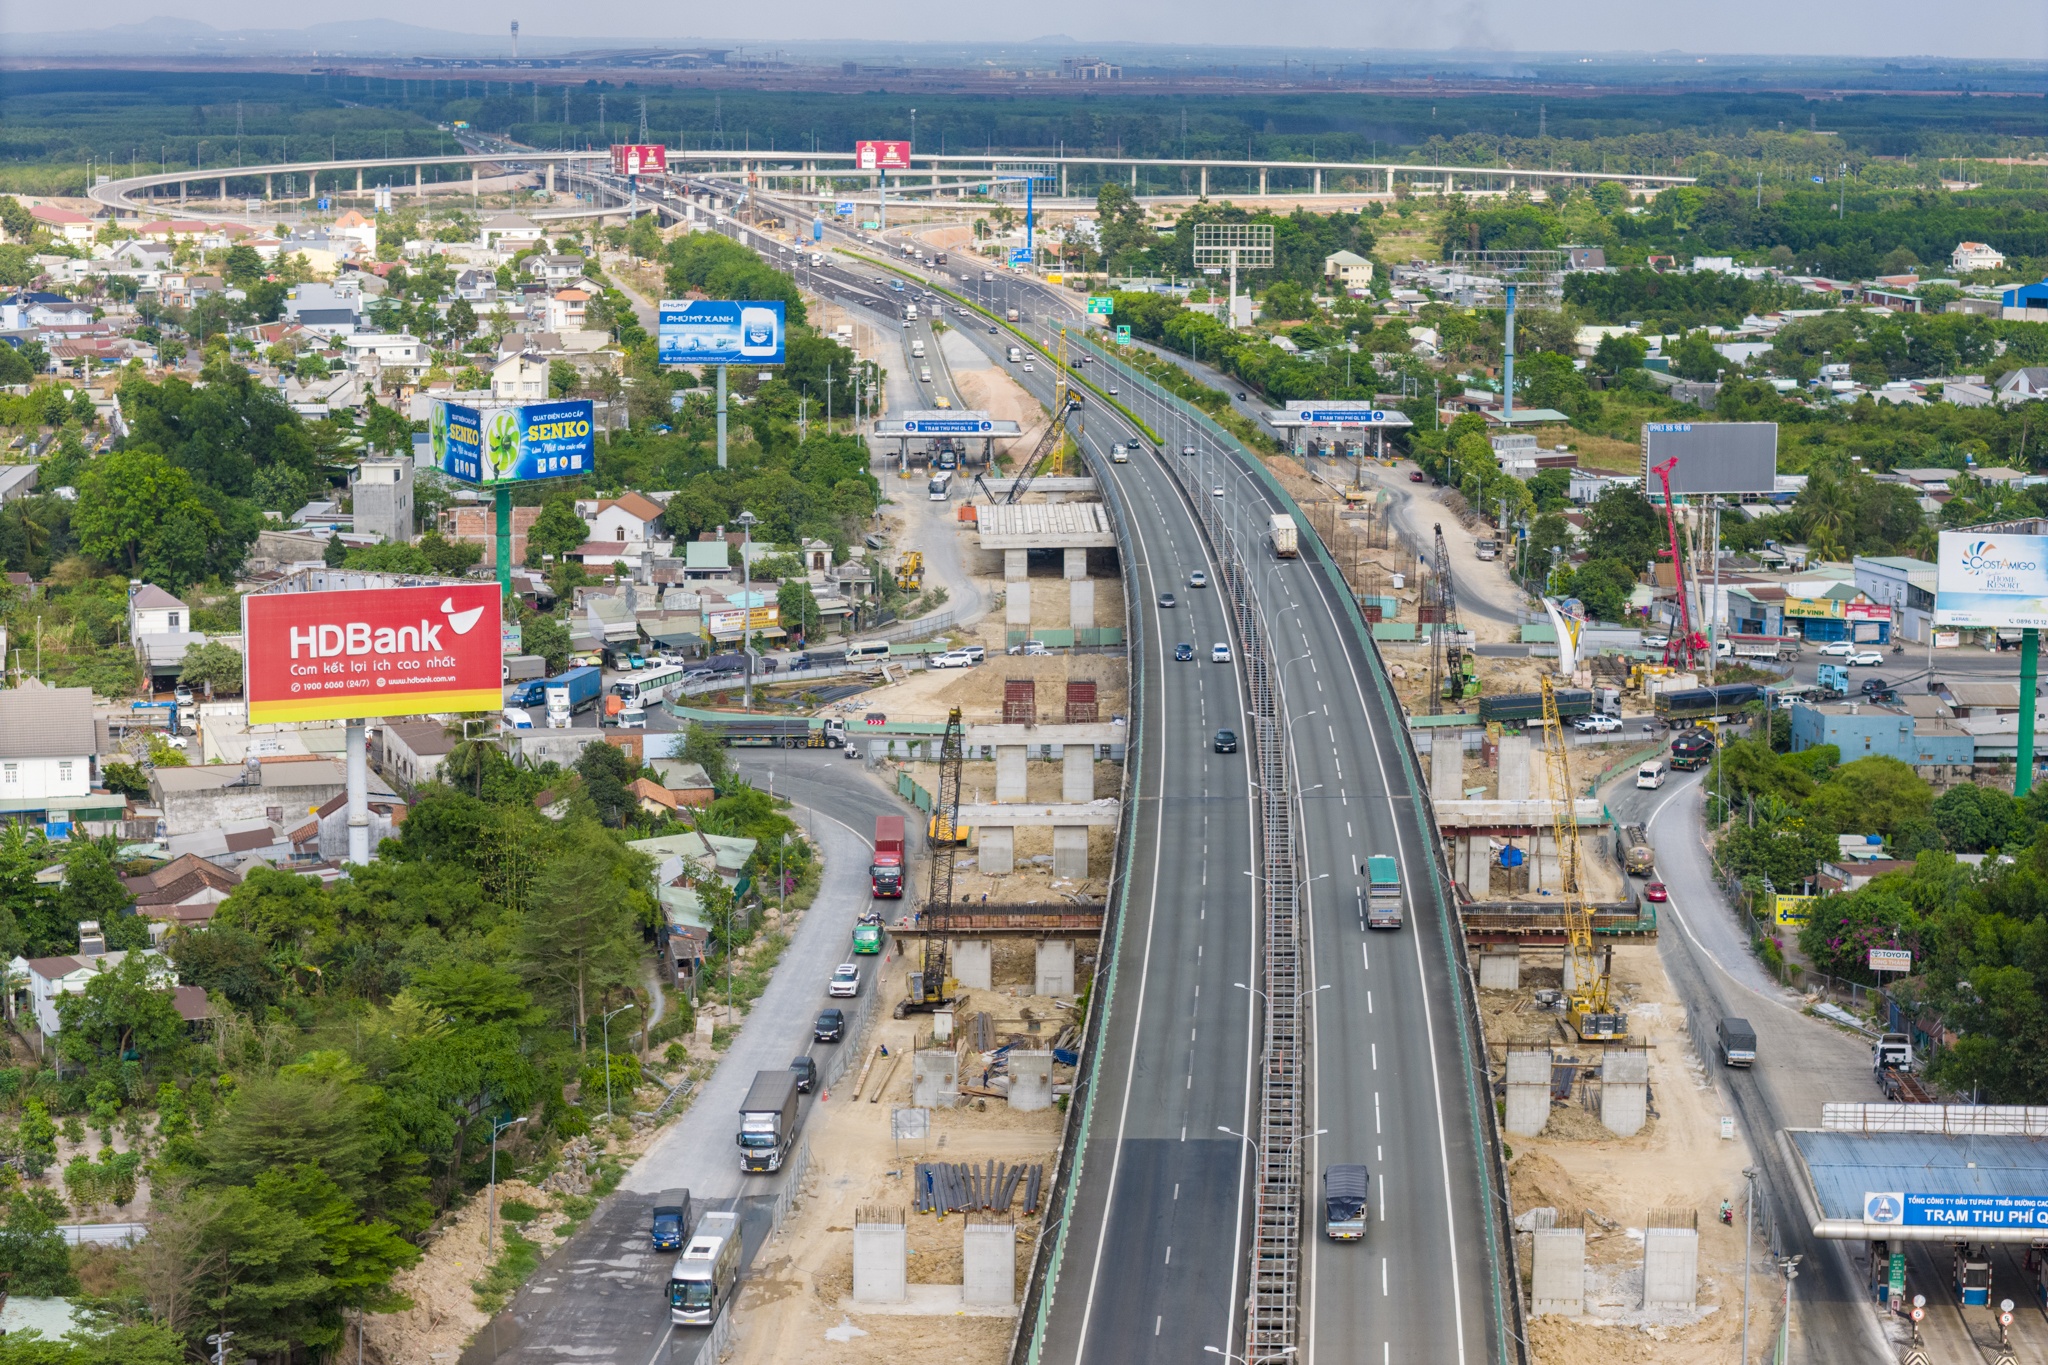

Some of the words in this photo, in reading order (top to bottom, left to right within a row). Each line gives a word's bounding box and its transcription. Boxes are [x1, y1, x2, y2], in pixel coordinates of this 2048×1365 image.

[450, 423, 479, 446] SENKO
[528, 420, 589, 441] SENKO
[1987, 580, 2020, 589] RESORT
[290, 619, 443, 659] HDBank
[290, 664, 318, 676] Cam
[324, 661, 344, 673] kết
[351, 661, 366, 674] lợi
[373, 659, 390, 671] ích
[397, 660, 420, 670] cao
[426, 656, 456, 669] nhất
[304, 682, 322, 690] 1900
[324, 681, 344, 689] 6060
[347, 679, 369, 689] (24/7)
[389, 676, 456, 685] www.hdbank.com.vn
[1908, 1195, 1925, 1204] TỔNG
[1978, 1197, 1993, 1206] PHÁT
[1996, 1197, 2013, 1206] TRIỂN
[1924, 1209, 1968, 1224] TRẠM
[1973, 1210, 2004, 1222] THU
[2009, 1208, 2035, 1223] PHÍ
